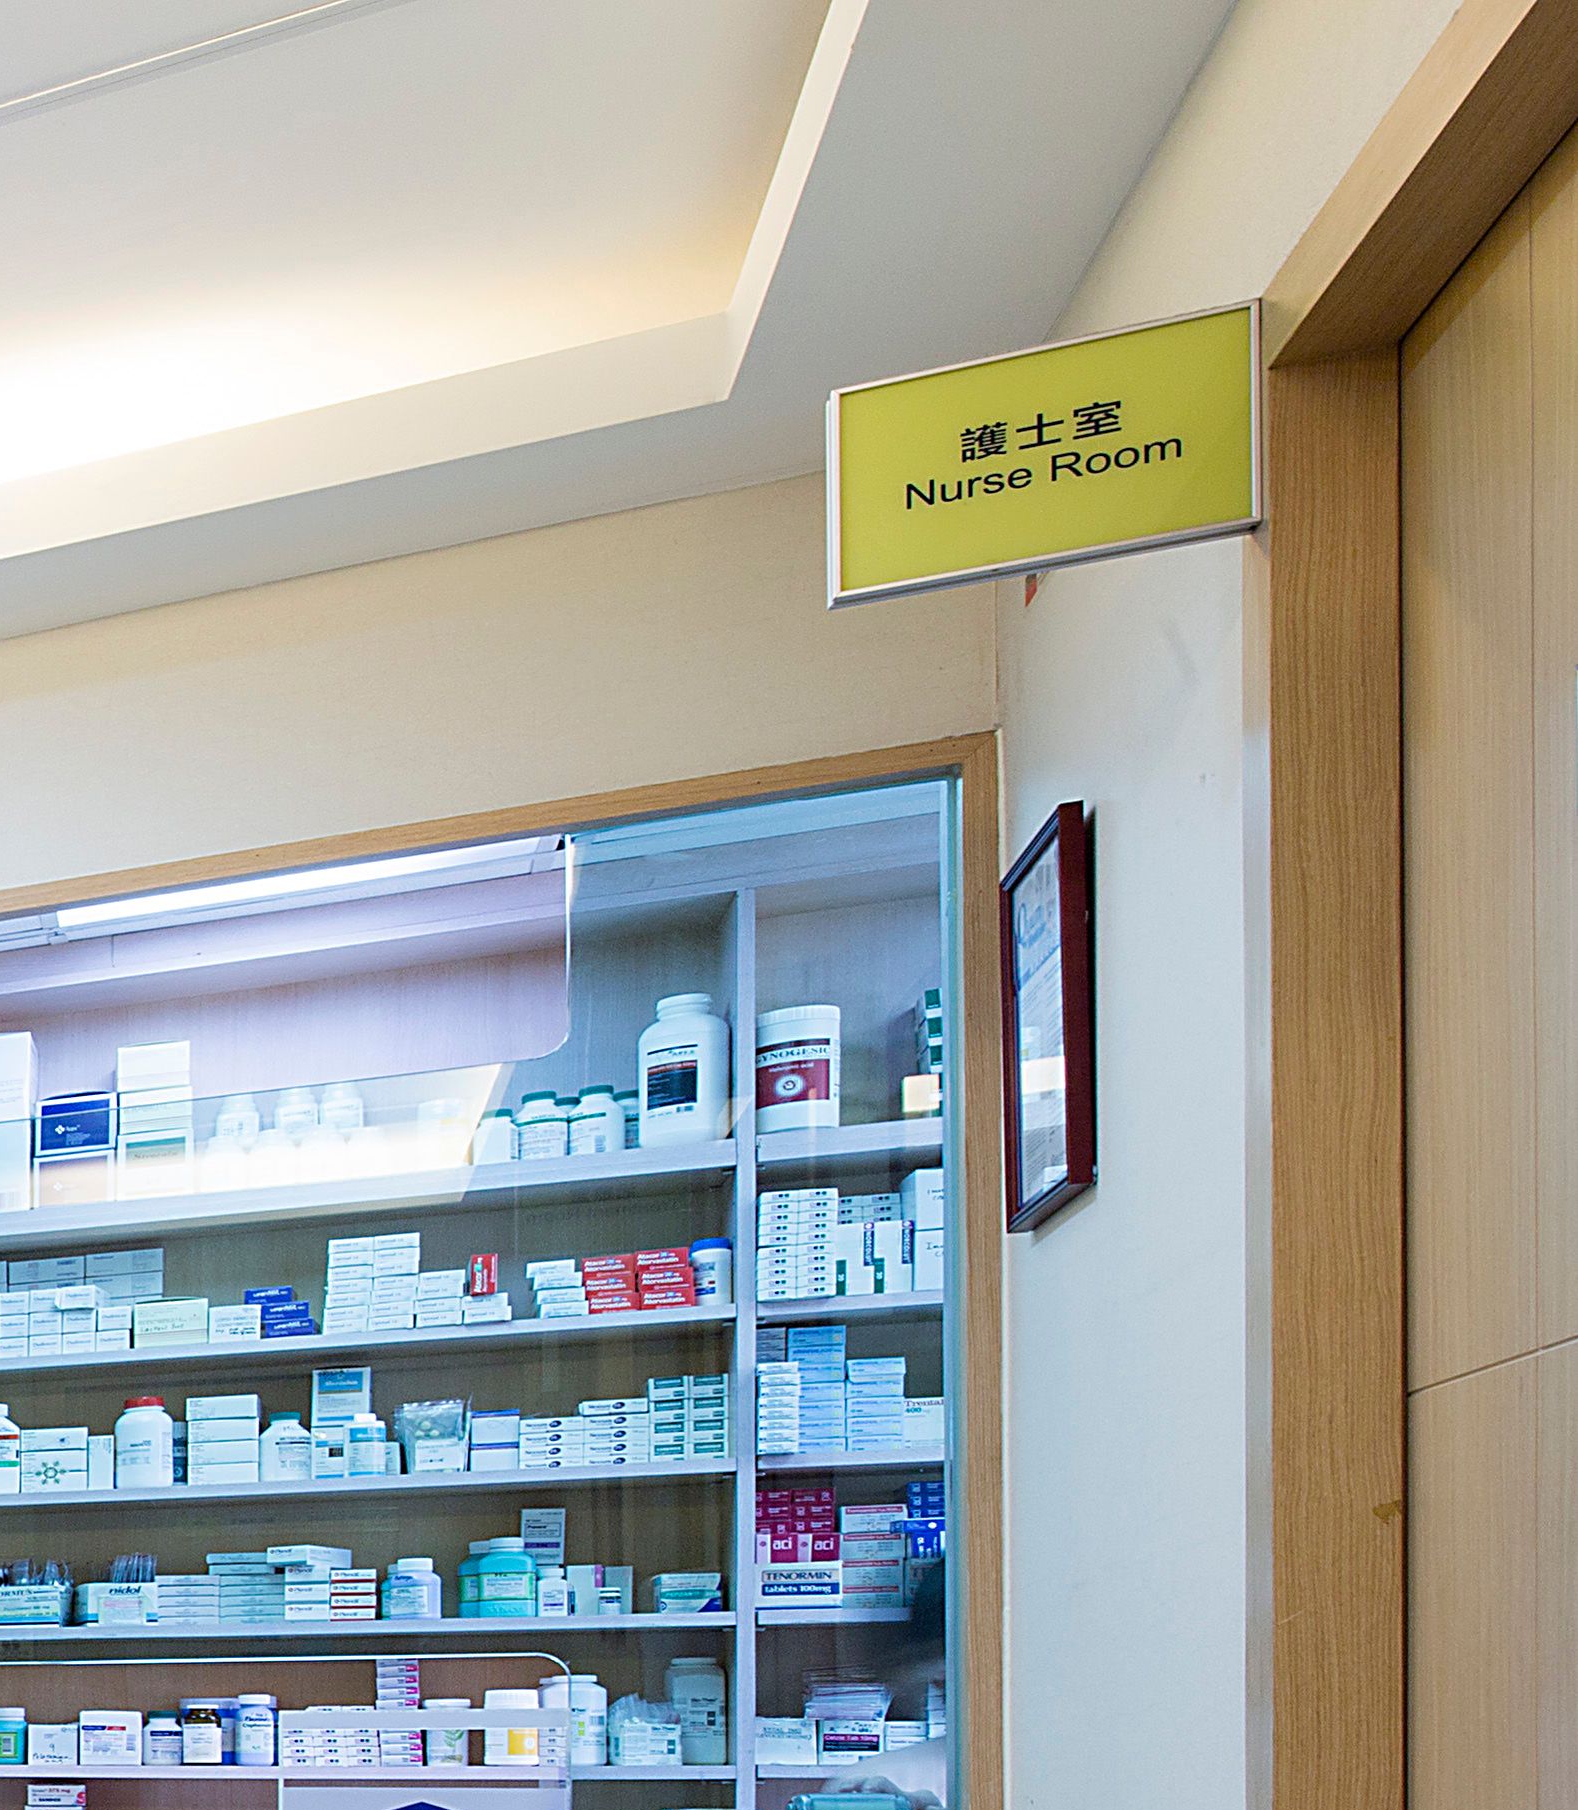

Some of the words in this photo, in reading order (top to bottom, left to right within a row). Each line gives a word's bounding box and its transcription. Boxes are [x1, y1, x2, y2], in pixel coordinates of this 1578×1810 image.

[960, 400, 1123, 463] 護士室
[905, 467, 1033, 510] Nurse
[1050, 436, 1183, 483] Room
[765, 1571, 832, 1581] TENORMIN
[765, 1584, 798, 1594] tablets
[799, 1584, 832, 1594] 100mg
